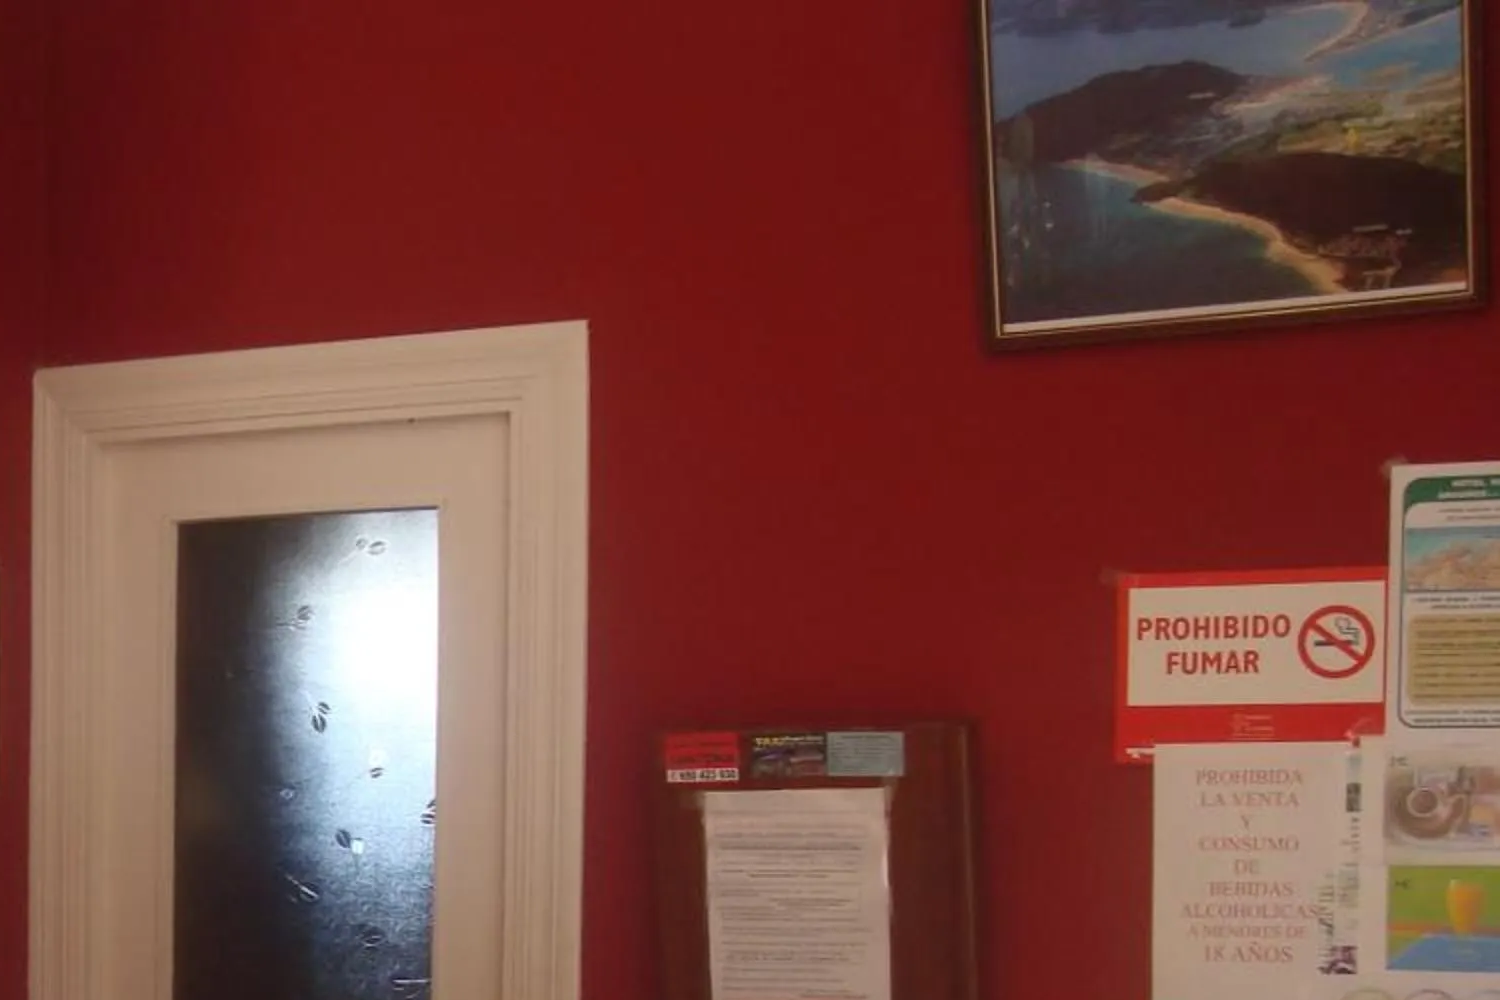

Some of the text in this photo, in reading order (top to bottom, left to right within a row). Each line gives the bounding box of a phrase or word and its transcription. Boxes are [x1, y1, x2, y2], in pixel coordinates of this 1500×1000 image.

[1136, 614, 1292, 641] PROHIBIDO
[1165, 650, 1260, 675] FUMAR
[1196, 767, 1303, 786] PROHIBIDA
[1200, 791, 1301, 807] LA VENTA
[1198, 835, 1300, 851] CONSUMO
[1234, 859, 1260, 875] DE
[1209, 881, 1294, 897] BEBIDAS
[1203, 925, 1282, 938] MENORES
[1286, 926, 1307, 939] DE
[1204, 941, 1295, 963] 18 AÑOS
